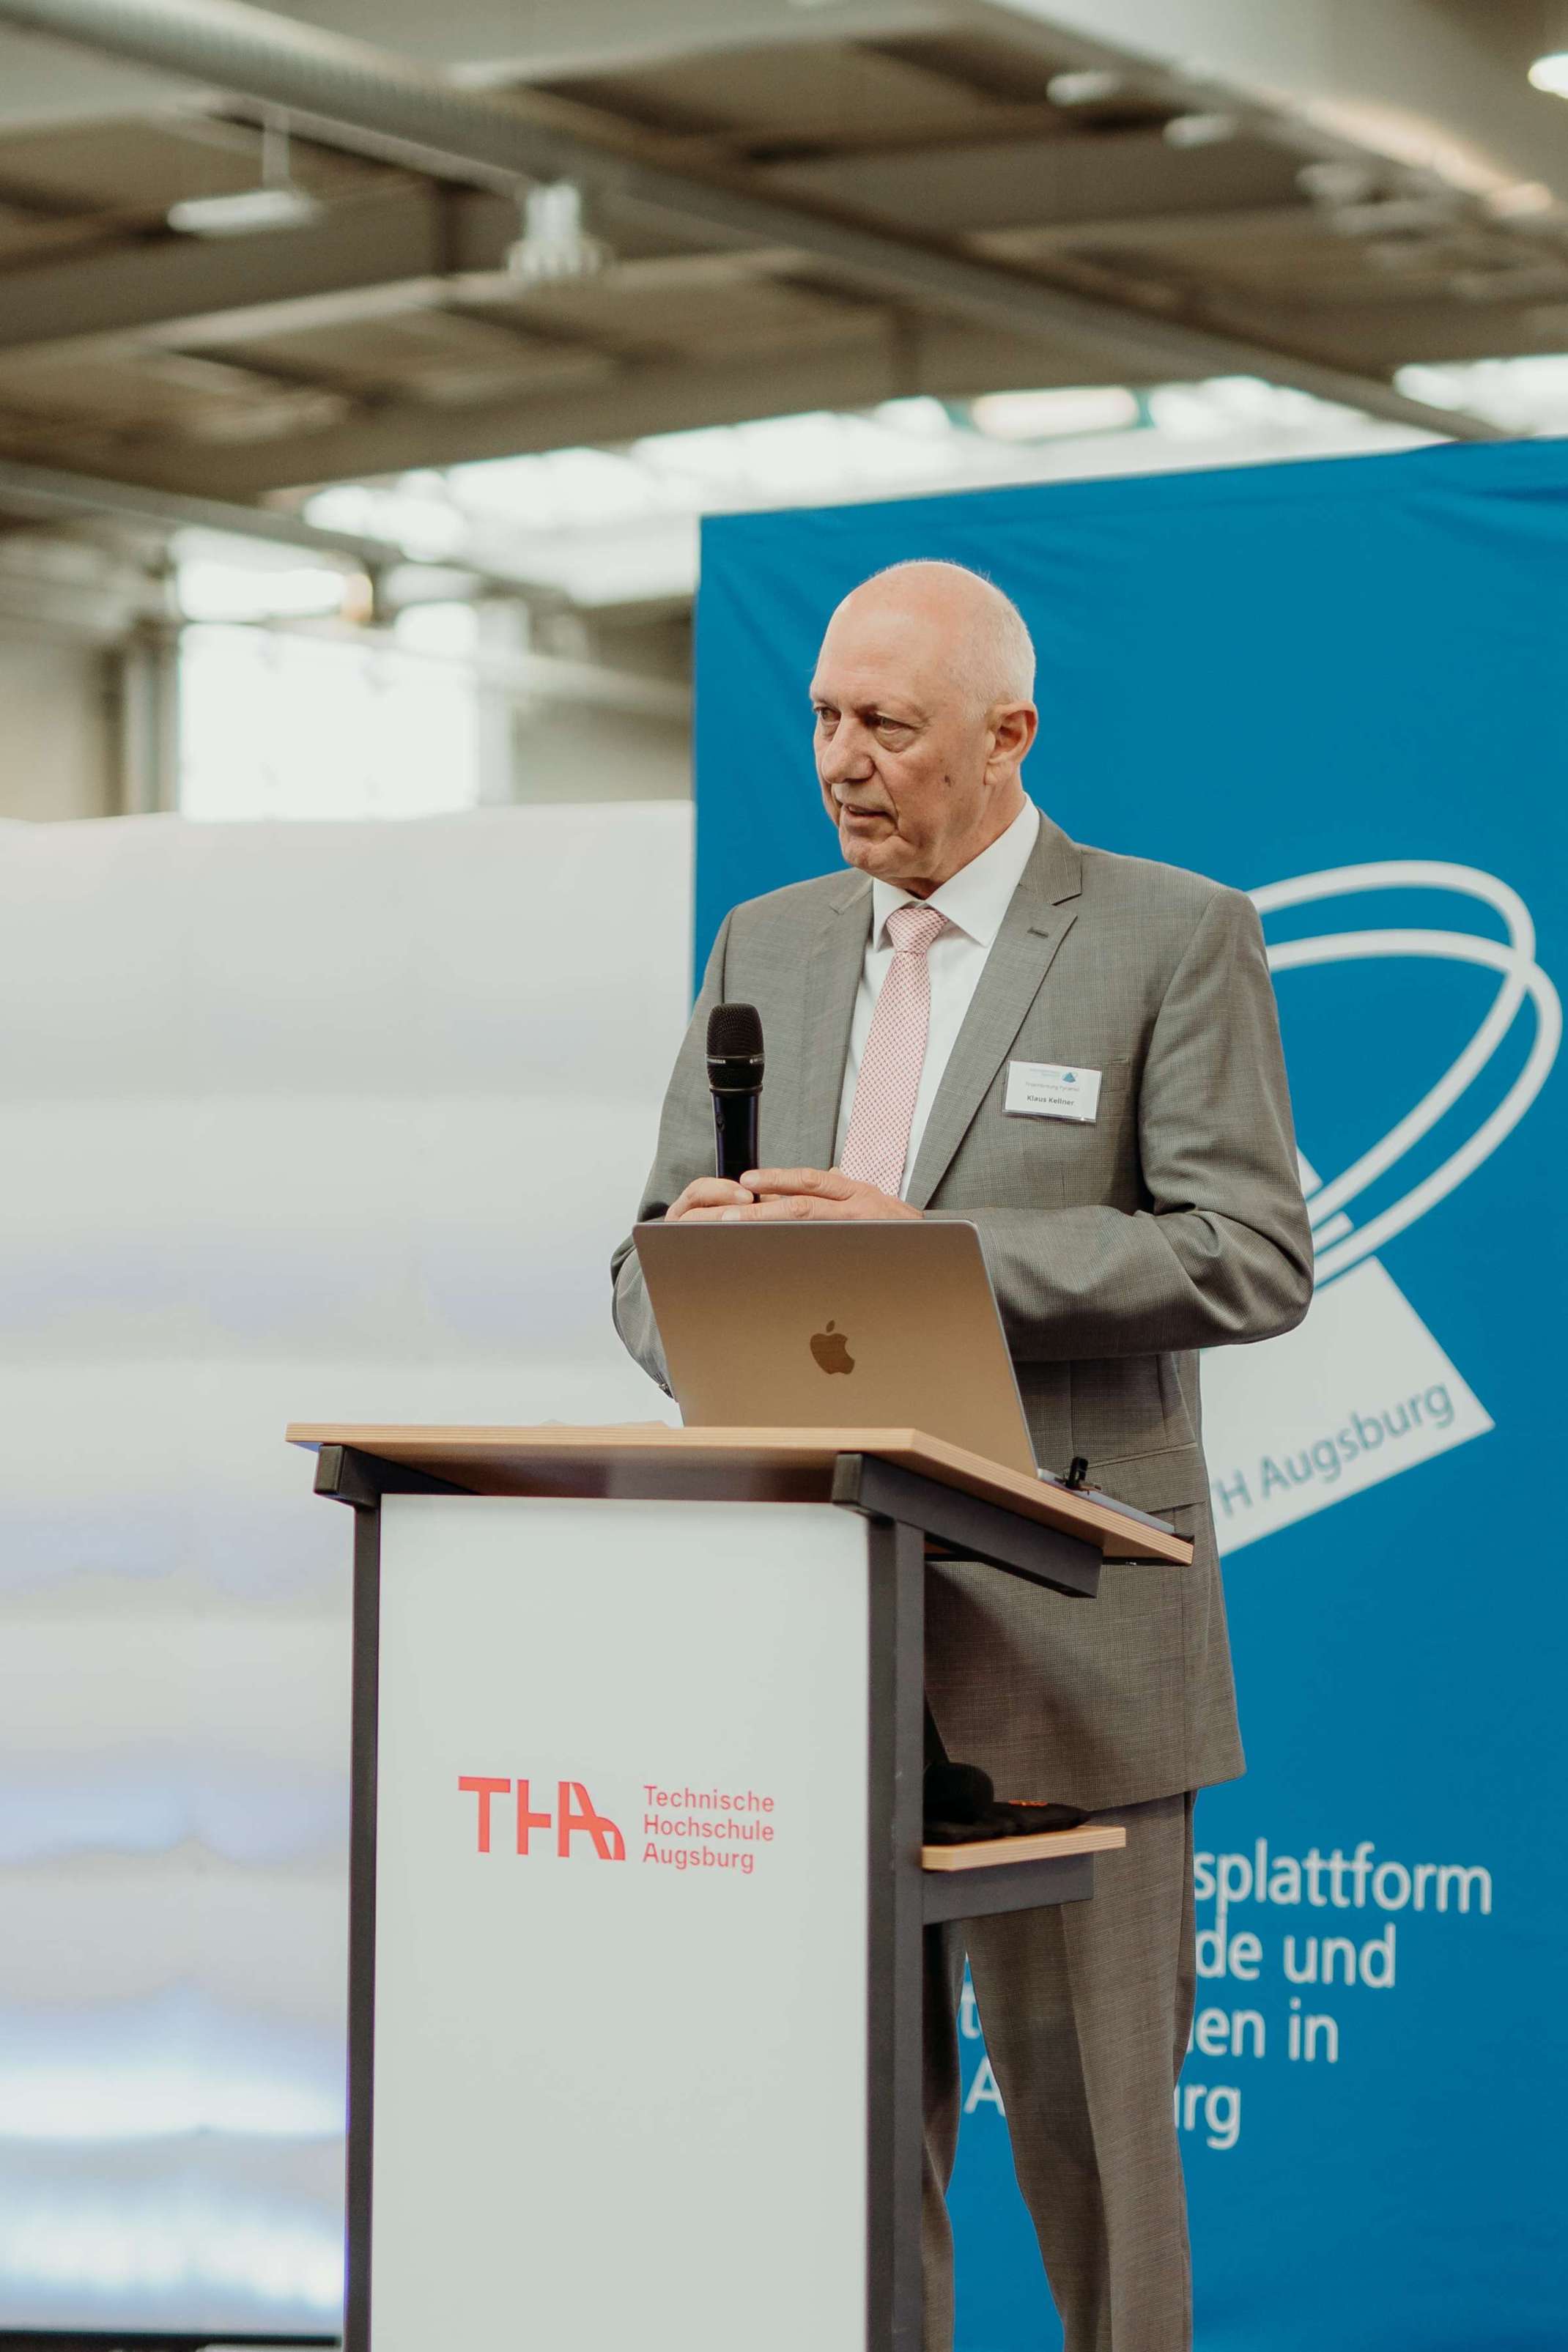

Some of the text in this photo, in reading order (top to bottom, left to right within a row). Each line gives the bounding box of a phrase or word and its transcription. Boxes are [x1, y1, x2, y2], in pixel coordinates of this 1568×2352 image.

[1027, 1095, 1046, 1103] Klaus
[1260, 1382, 1455, 1501] Augsburg
[458, 1775, 626, 1861] THA
[643, 1785, 774, 1812] Technische
[643, 1813, 774, 1841] Hochschule
[643, 1842, 754, 1874] Augsburg
[1194, 1837, 1493, 1917] splattform
[1284, 1923, 1397, 1989] und
[1187, 2007, 1266, 2059] en
[1289, 1996, 1339, 2064] in
